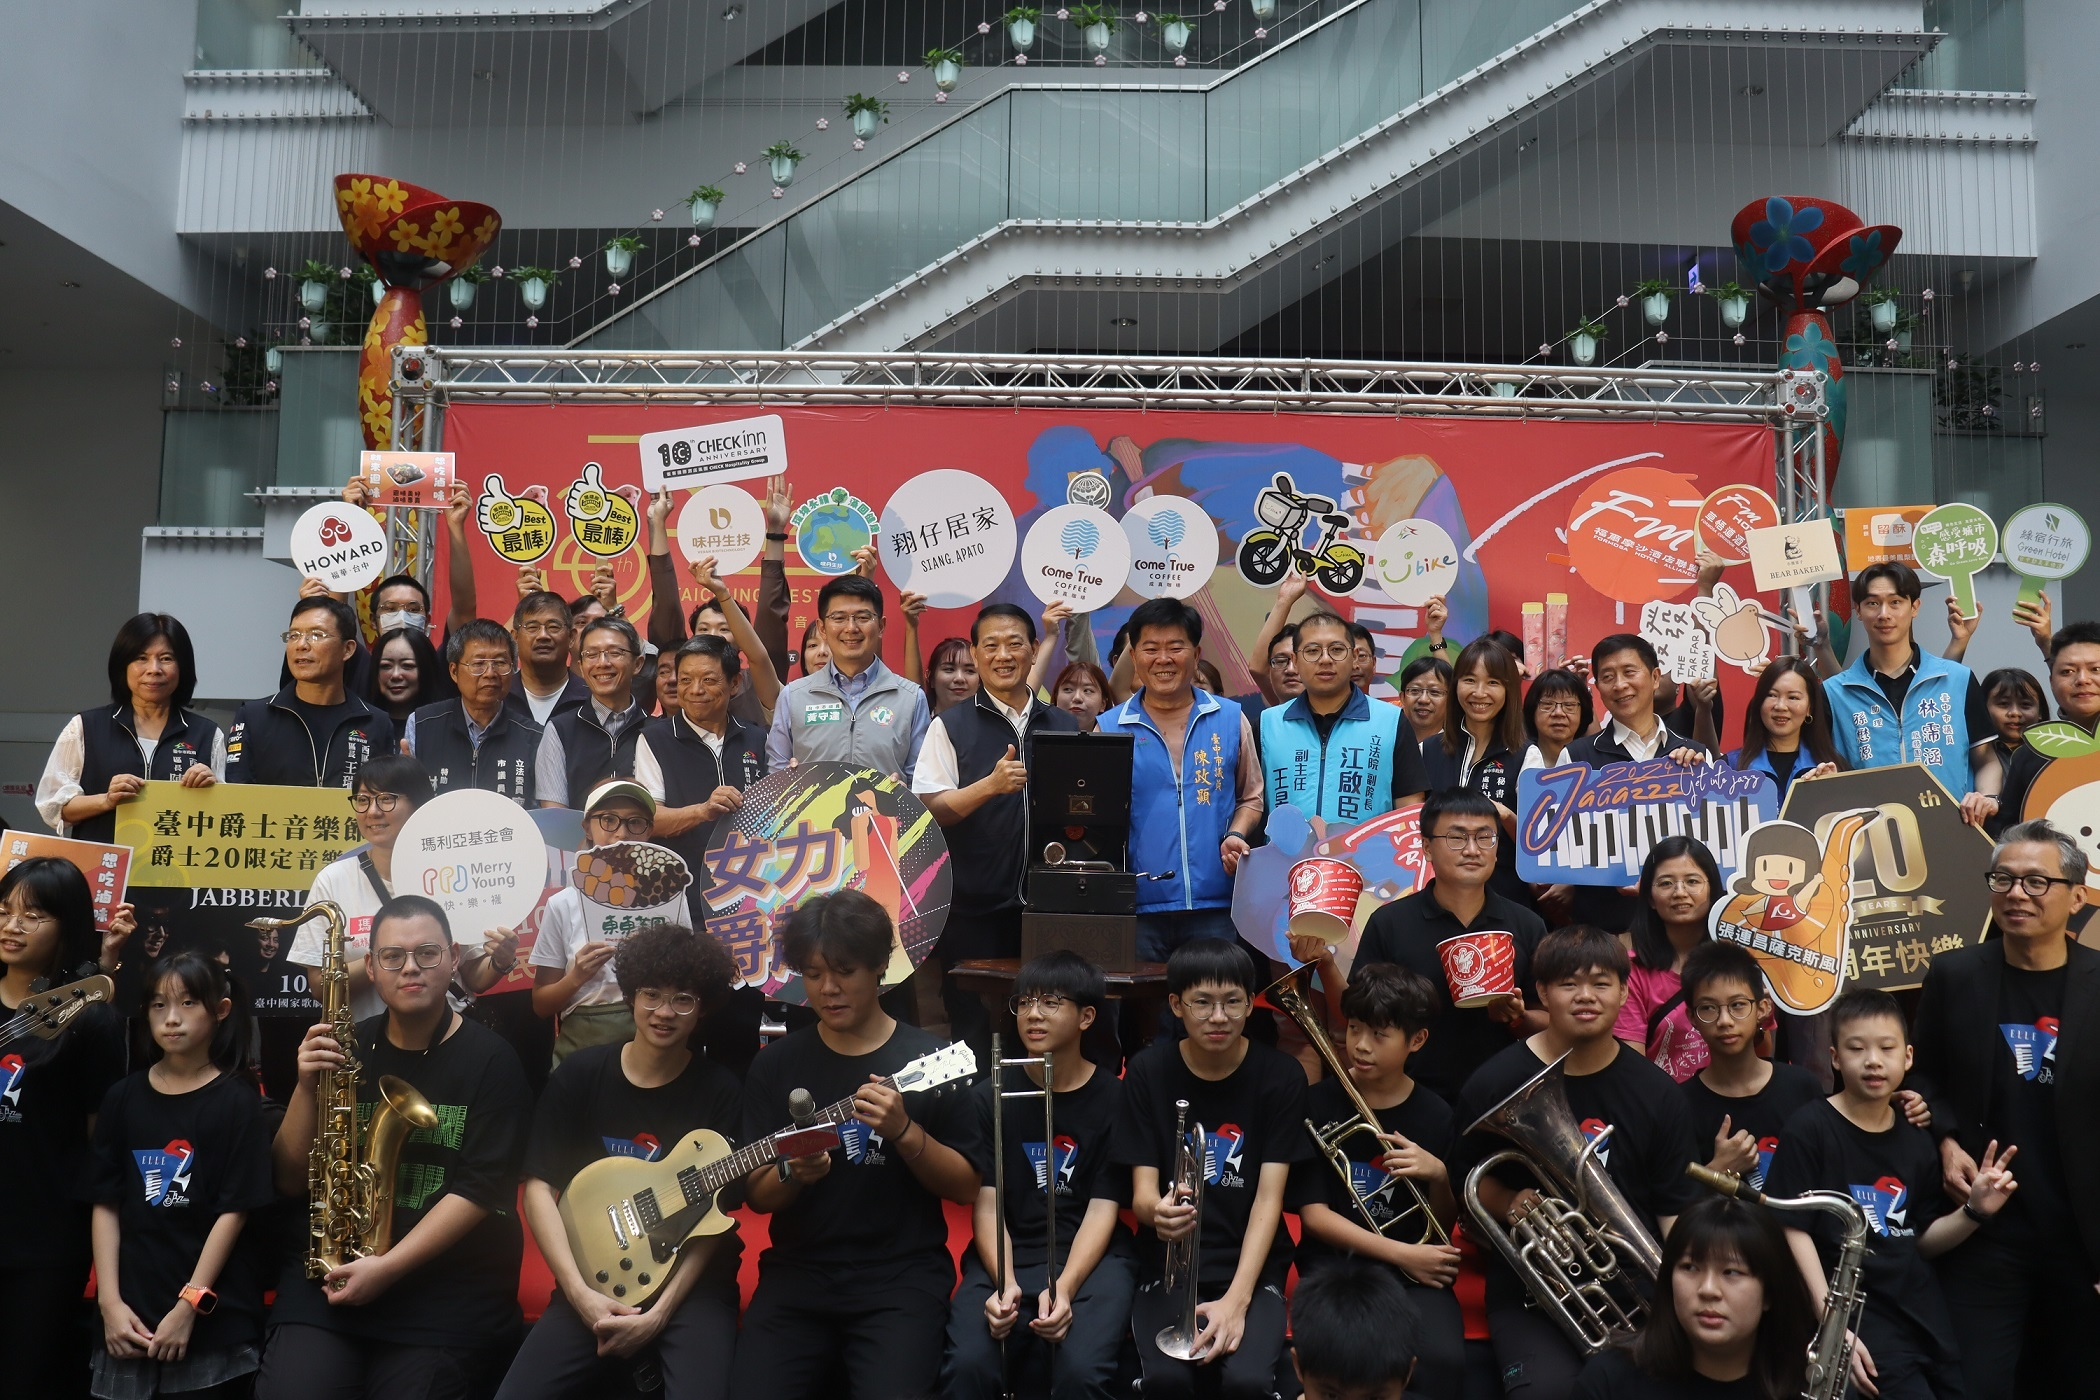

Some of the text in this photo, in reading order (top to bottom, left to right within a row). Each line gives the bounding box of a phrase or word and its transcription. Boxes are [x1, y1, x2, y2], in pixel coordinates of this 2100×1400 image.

[697, 435, 741, 454] CHECK
[699, 446, 767, 462] ANNIVERSARY
[524, 514, 547, 525] Best
[610, 510, 632, 525] Best
[1732, 514, 1754, 530] HO
[502, 530, 549, 553] 最棒!
[582, 523, 630, 546] 最棒!
[692, 533, 751, 548] 味丹生技
[891, 506, 999, 557] 翔仔居家
[1939, 522, 1986, 542] 感受城市
[2019, 529, 2074, 550] 綠宿行旅
[303, 540, 383, 573] HOWARD
[955, 542, 985, 563] APATO
[1593, 526, 1700, 574] 福爾摩沙酒店聯盟
[1593, 534, 1698, 579] FORMOSA HOTEL ALLIANCE
[1926, 537, 1989, 568] 森呼吸
[2017, 541, 2071, 562] Green Hotel
[1041, 564, 1103, 586] Come True
[1134, 559, 1195, 572] Come True
[1770, 564, 1825, 580] BEAR BAKERY
[1054, 580, 1088, 594] COFFEE
[1149, 573, 1181, 581] COFFEE
[678, 587, 820, 603] TAICUNG EST
[794, 615, 808, 629] 音
[1677, 655, 1686, 678] THE
[1688, 634, 1700, 678] FAR FAR
[1700, 649, 1710, 680] FARM
[1911, 730, 1922, 762] 服務團
[1210, 732, 1225, 792] 臺中市議員
[1293, 749, 1309, 792] 副主任
[515, 759, 525, 795] 立法委員
[1364, 735, 1382, 811] 立法院 副院長
[1600, 761, 1675, 786] 2024
[1710, 770, 1728, 788] into
[1729, 772, 1760, 796] jazz
[1917, 789, 1941, 809] th
[421, 826, 514, 852] 瑪利亞基金會
[470, 861, 513, 876] Merry
[703, 820, 842, 904] 女力
[93, 851, 119, 923] 想吃滷味
[471, 874, 516, 890] Young
[1860, 899, 1898, 913] YEARS
[357, 918, 372, 932] 瑪
[1716, 920, 1839, 976] 張連昌薩克斯風
[2010, 1028, 2037, 1042] ELLE
[611, 1143, 635, 1154] ELLE
[141, 1155, 167, 1166] ELLE
[1354, 1167, 1372, 1178] LLE
[1856, 1189, 1878, 1202] ELLE
